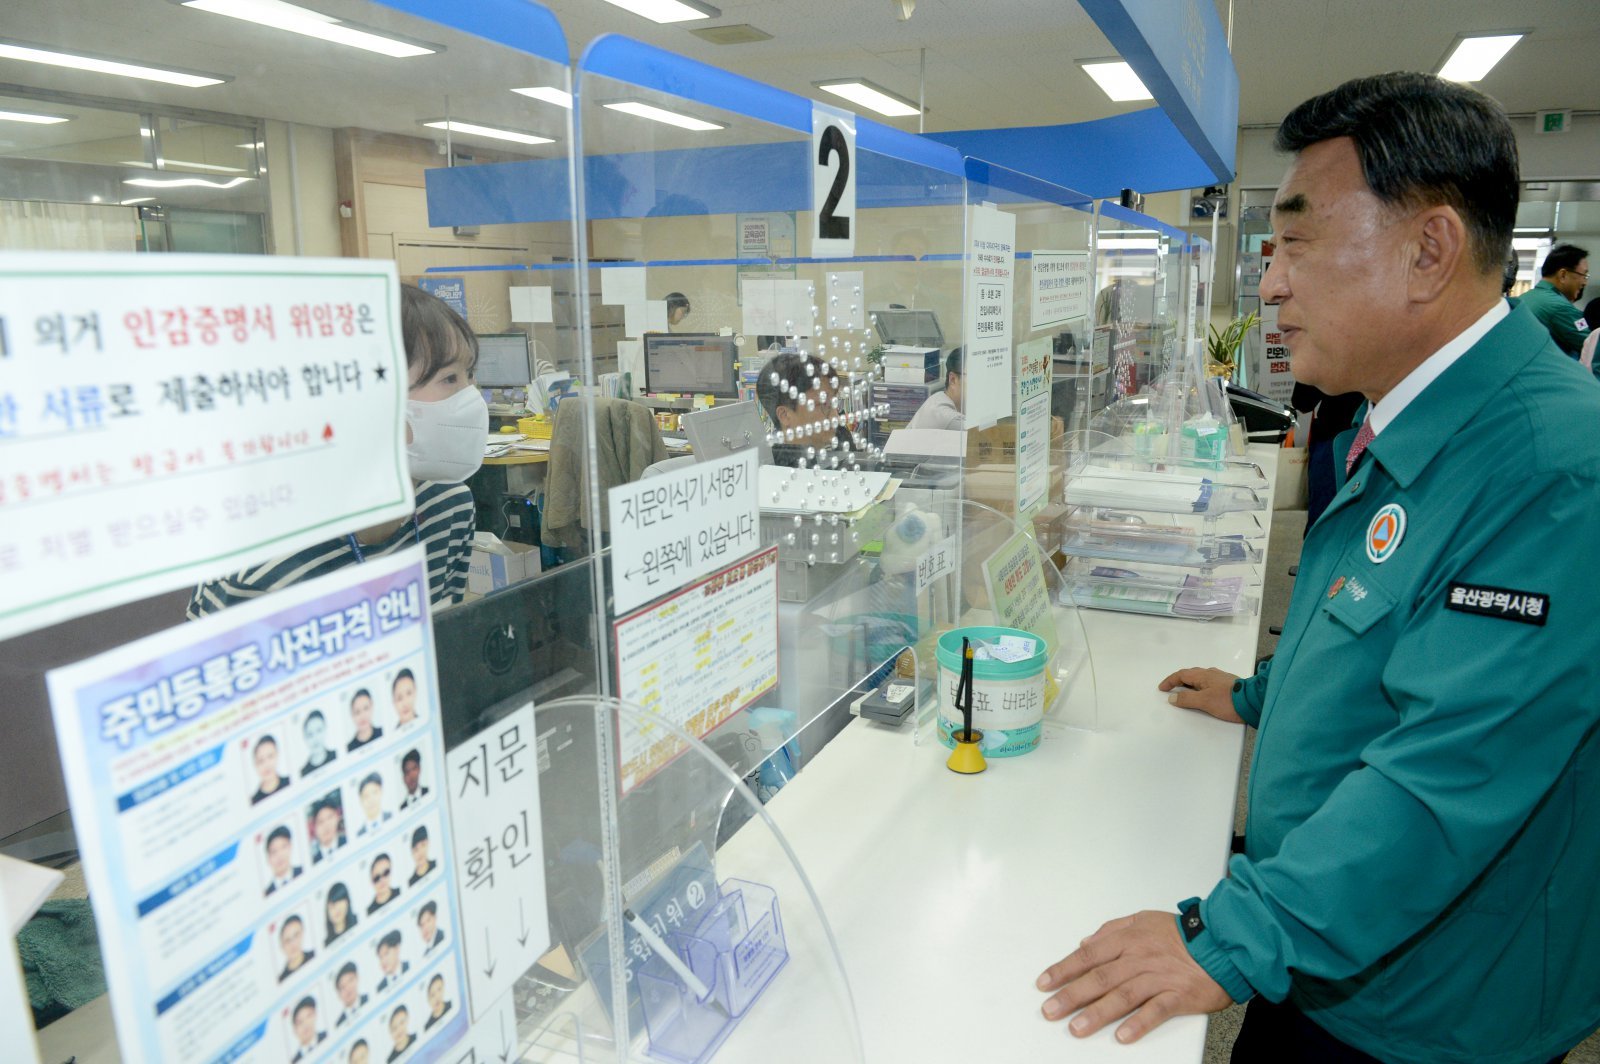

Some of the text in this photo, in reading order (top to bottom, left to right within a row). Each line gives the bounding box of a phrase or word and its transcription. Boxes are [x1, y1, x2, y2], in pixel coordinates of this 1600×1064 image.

[818, 125, 850, 240] 2
[35, 310, 103, 352] 의거
[123, 304, 278, 348] 인감증명서
[290, 303, 375, 338] 위임장은
[302, 360, 363, 398] 합니다
[642, 534, 692, 586] 왼쪽에
[919, 550, 946, 588] 번호표
[1450, 586, 1544, 617] 울산광역시청
[102, 645, 264, 746] 주민등록증
[267, 608, 373, 682] 사진규격
[376, 583, 422, 633] 안내
[1001, 687, 1038, 711] 버리는
[457, 724, 528, 799] 지문
[464, 808, 532, 892] 확인
